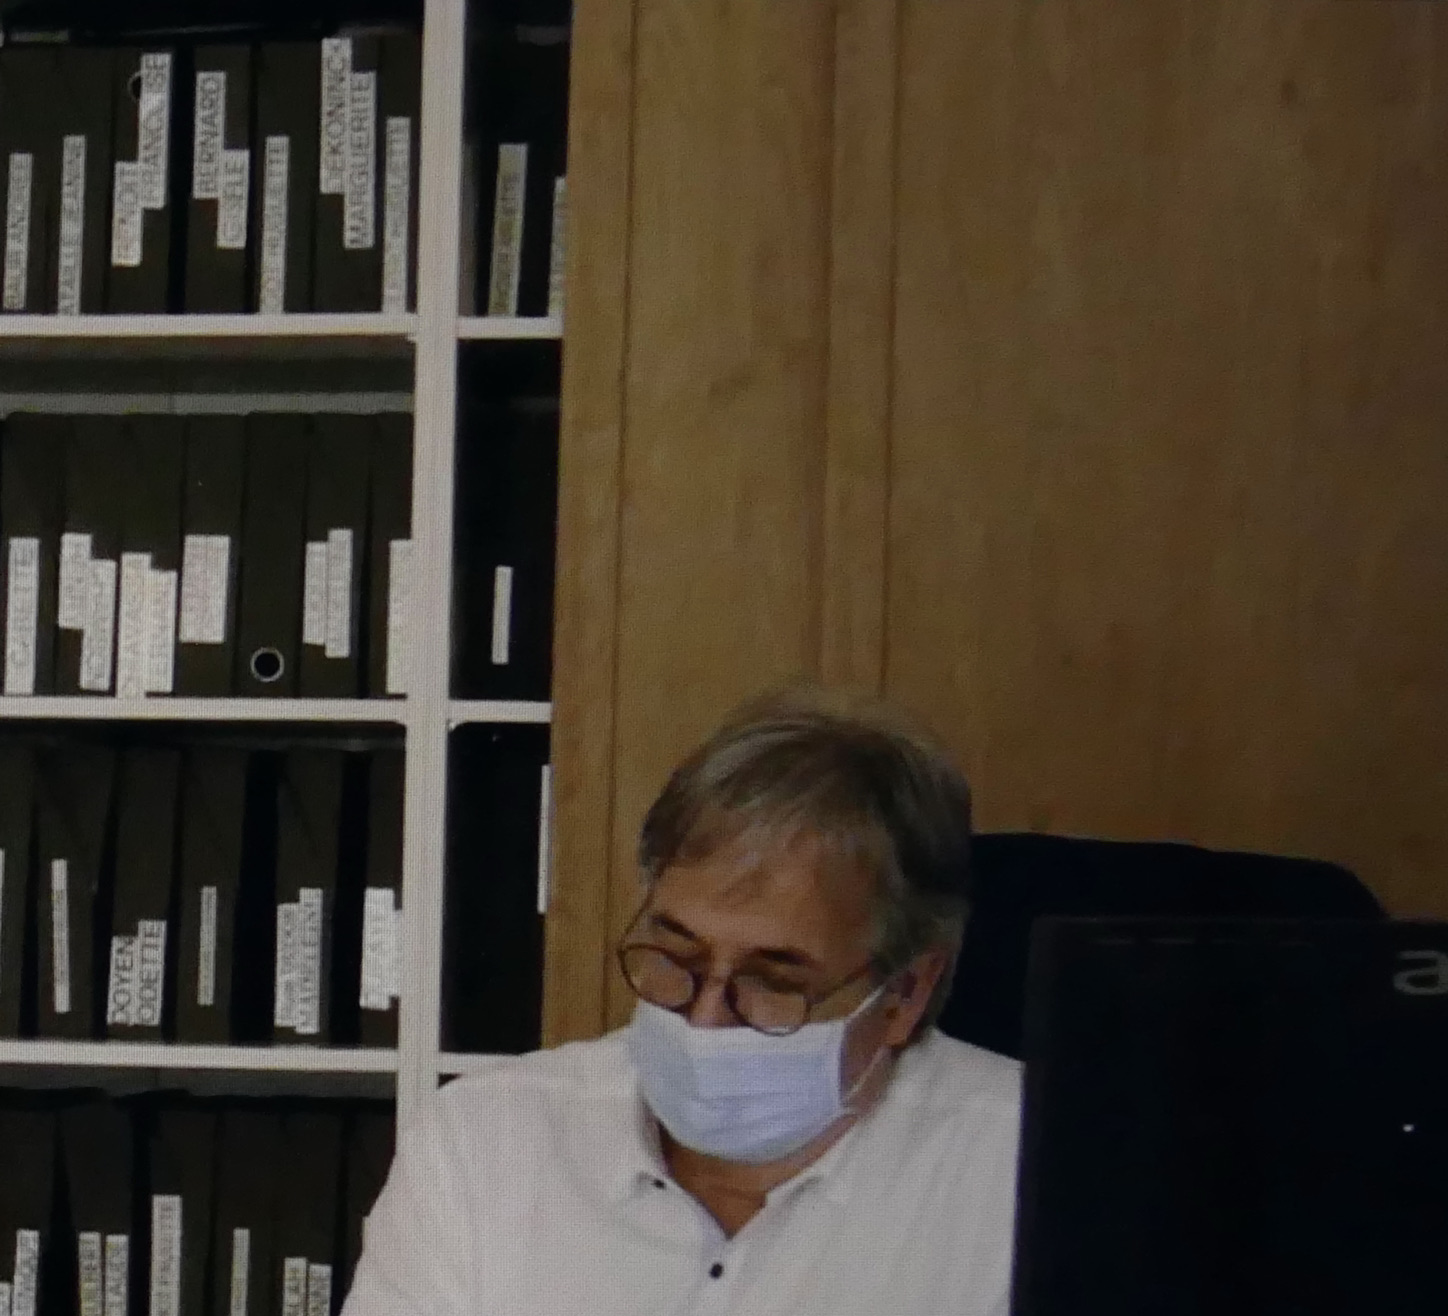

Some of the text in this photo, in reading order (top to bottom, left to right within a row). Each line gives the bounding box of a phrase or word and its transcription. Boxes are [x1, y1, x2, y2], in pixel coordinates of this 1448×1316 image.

[197, 75, 221, 194] BERNARD
[349, 75, 372, 245] MARGUERITE
[111, 936, 136, 1024] DOYEN
[137, 923, 162, 1022] ODETTE
